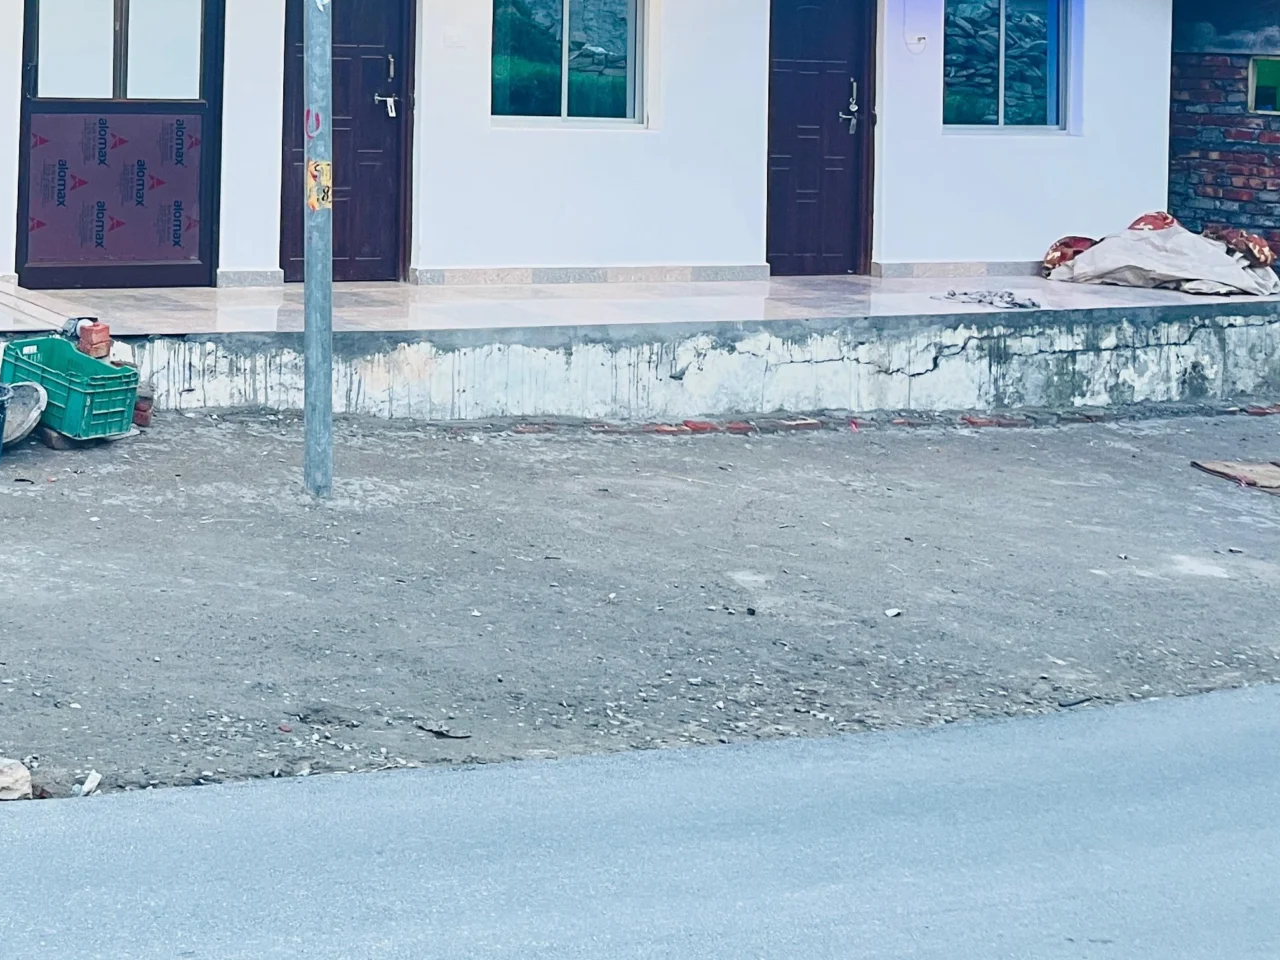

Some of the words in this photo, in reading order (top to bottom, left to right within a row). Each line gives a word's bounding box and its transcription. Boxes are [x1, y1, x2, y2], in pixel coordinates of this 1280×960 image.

[98, 118, 109, 166] alomax
[175, 119, 186, 166] alomax
[56, 159, 69, 207] alomax
[135, 159, 146, 207] alomax
[95, 200, 107, 248] alomax
[172, 200, 184, 247] alomax
